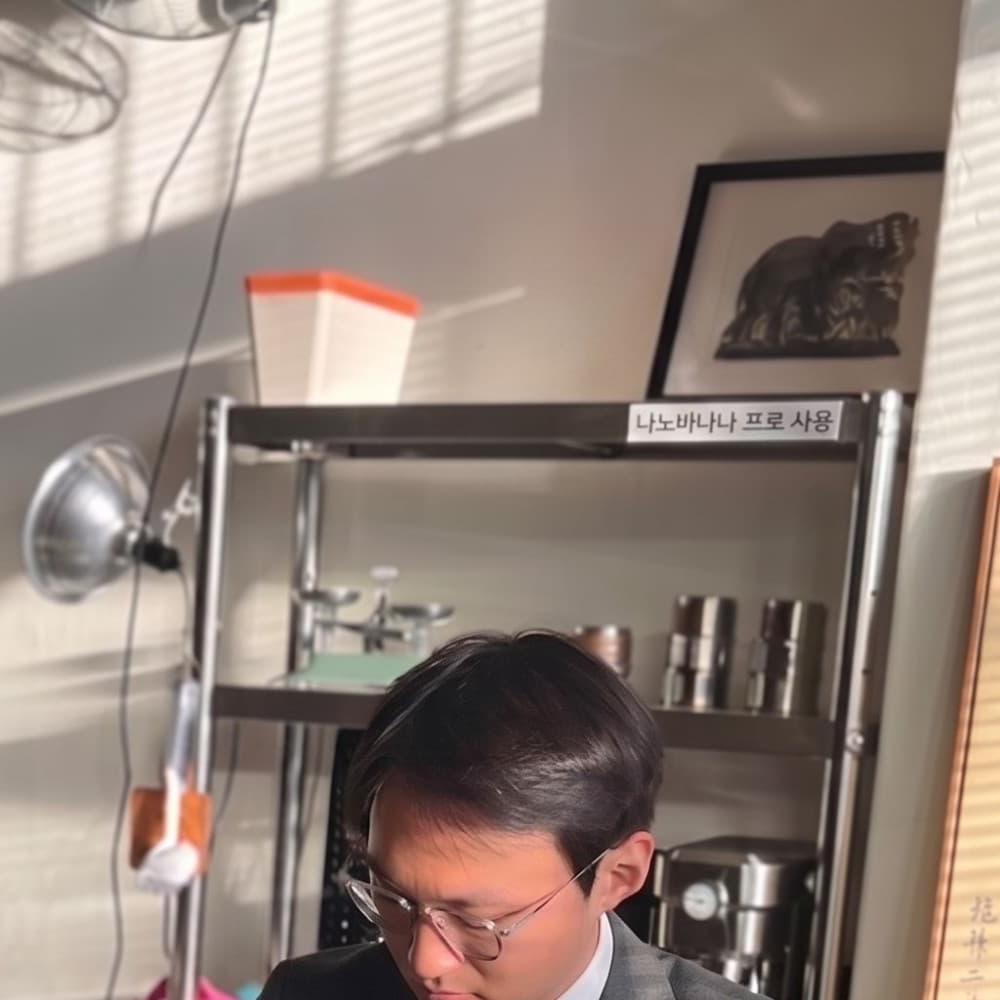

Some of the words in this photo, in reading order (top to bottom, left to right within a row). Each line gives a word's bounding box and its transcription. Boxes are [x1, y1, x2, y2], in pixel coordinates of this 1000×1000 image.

[636, 411, 737, 434] 나노바나나
[742, 411, 785, 431] 프로
[790, 409, 834, 433] 사용
